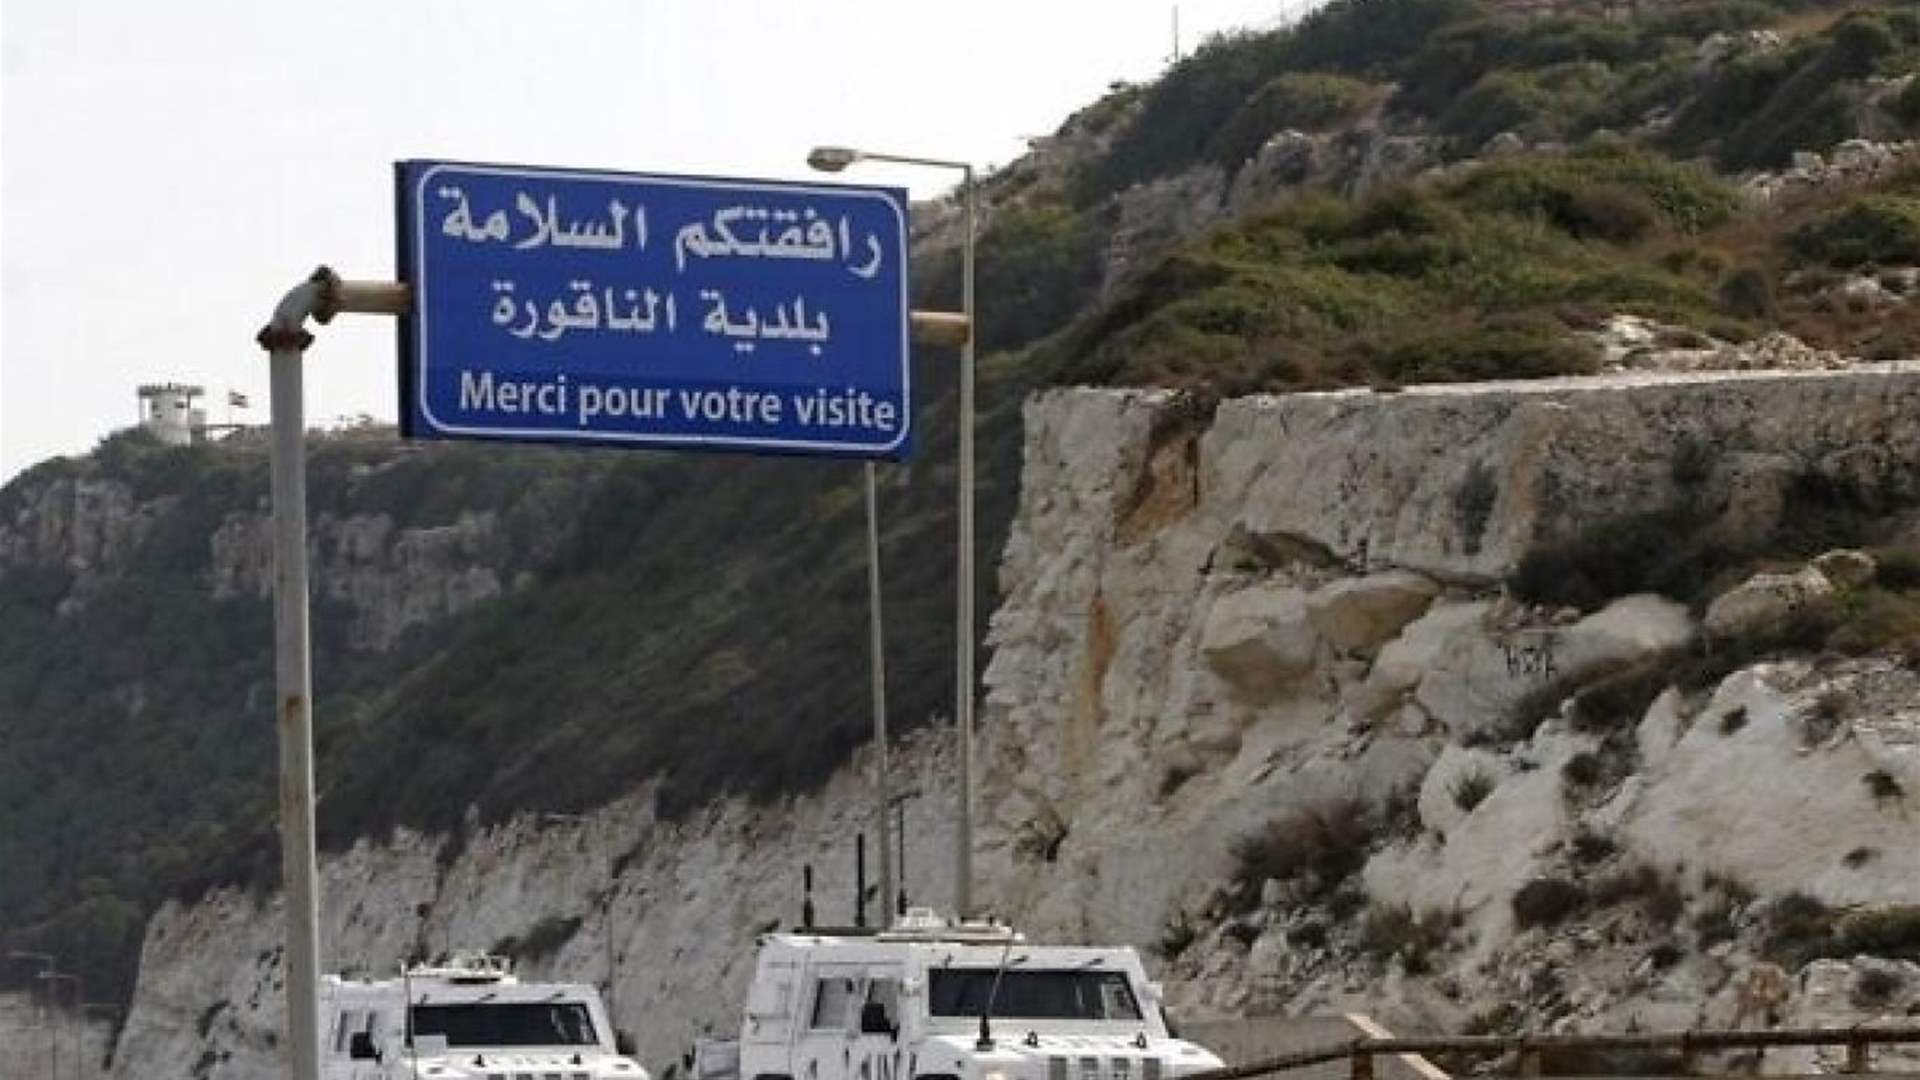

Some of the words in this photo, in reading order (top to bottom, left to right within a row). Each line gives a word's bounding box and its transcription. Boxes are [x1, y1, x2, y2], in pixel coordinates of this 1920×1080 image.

[437, 186, 648, 250] السلامة
[675, 205, 883, 278] رافقتكم
[492, 280, 677, 340] الناقورة
[700, 289, 831, 355] بلدية
[459, 370, 567, 413] Merci
[578, 387, 671, 425] pour
[681, 388, 781, 422] votre
[794, 388, 896, 431] visite
